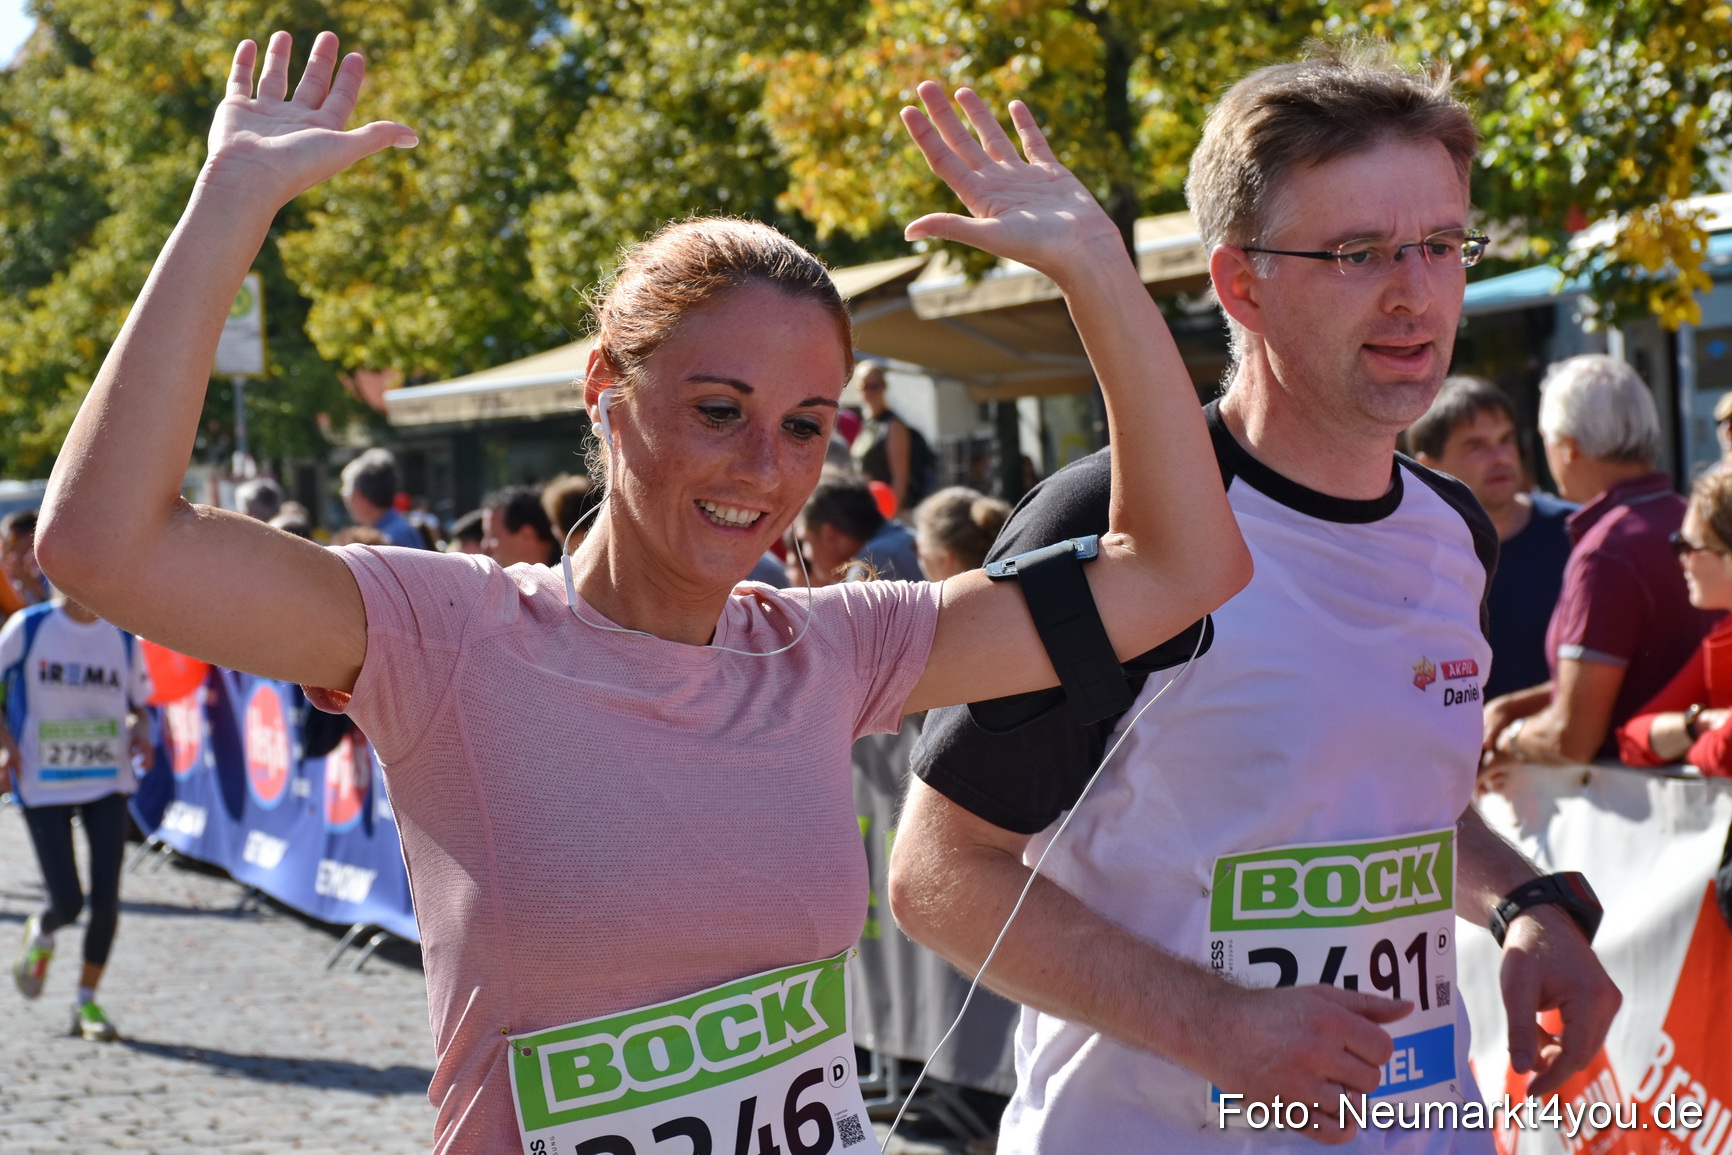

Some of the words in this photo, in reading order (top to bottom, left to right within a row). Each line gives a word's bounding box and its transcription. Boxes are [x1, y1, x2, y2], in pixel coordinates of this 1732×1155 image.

[1444, 682, 1480, 707] Daniel
[1239, 851, 1436, 912] BOCK
[1438, 934, 1447, 949] D
[545, 977, 819, 1104] BOCK
[832, 1063, 844, 1082] D
